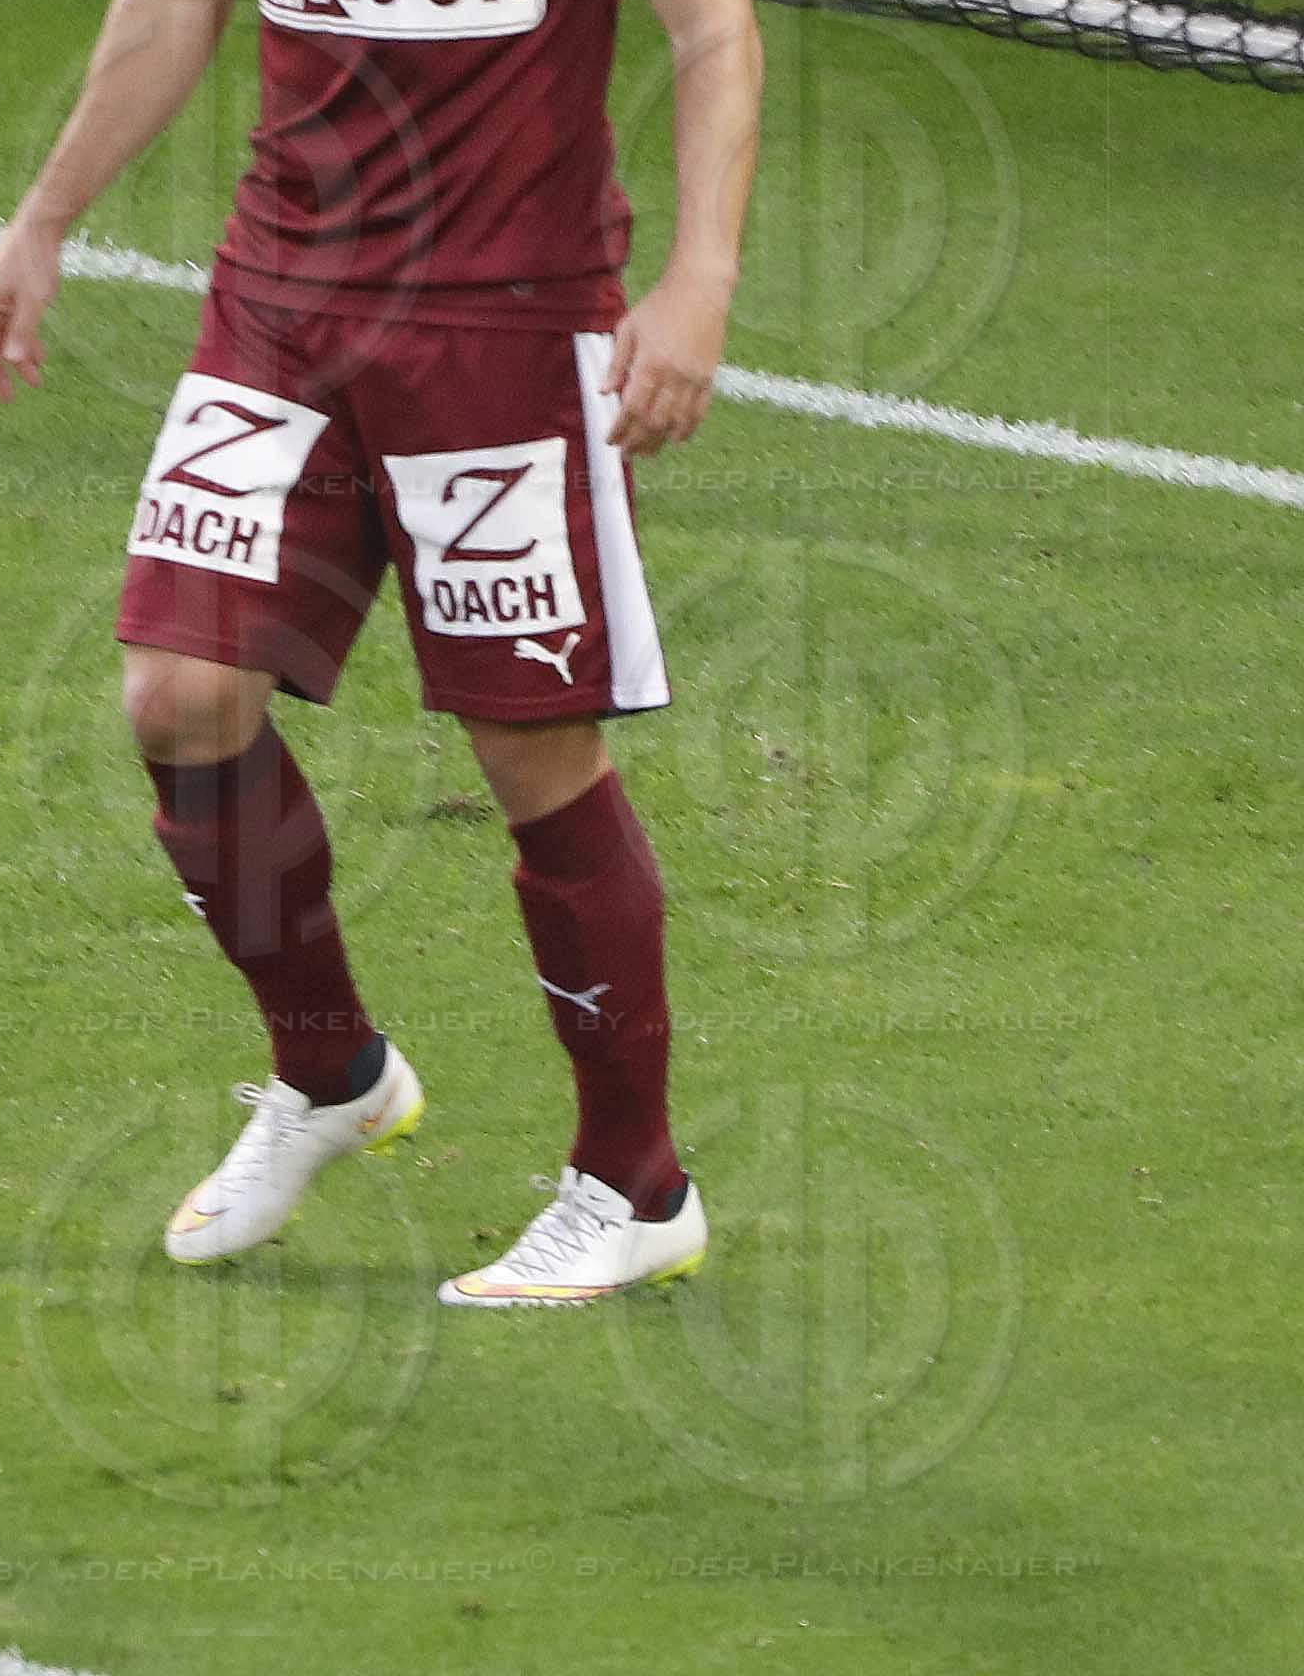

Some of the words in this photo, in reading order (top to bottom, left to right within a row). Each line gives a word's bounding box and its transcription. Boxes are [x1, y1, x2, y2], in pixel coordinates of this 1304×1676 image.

[159, 399, 290, 499] Z
[442, 461, 538, 563] Z
[433, 572, 559, 623] DACH
